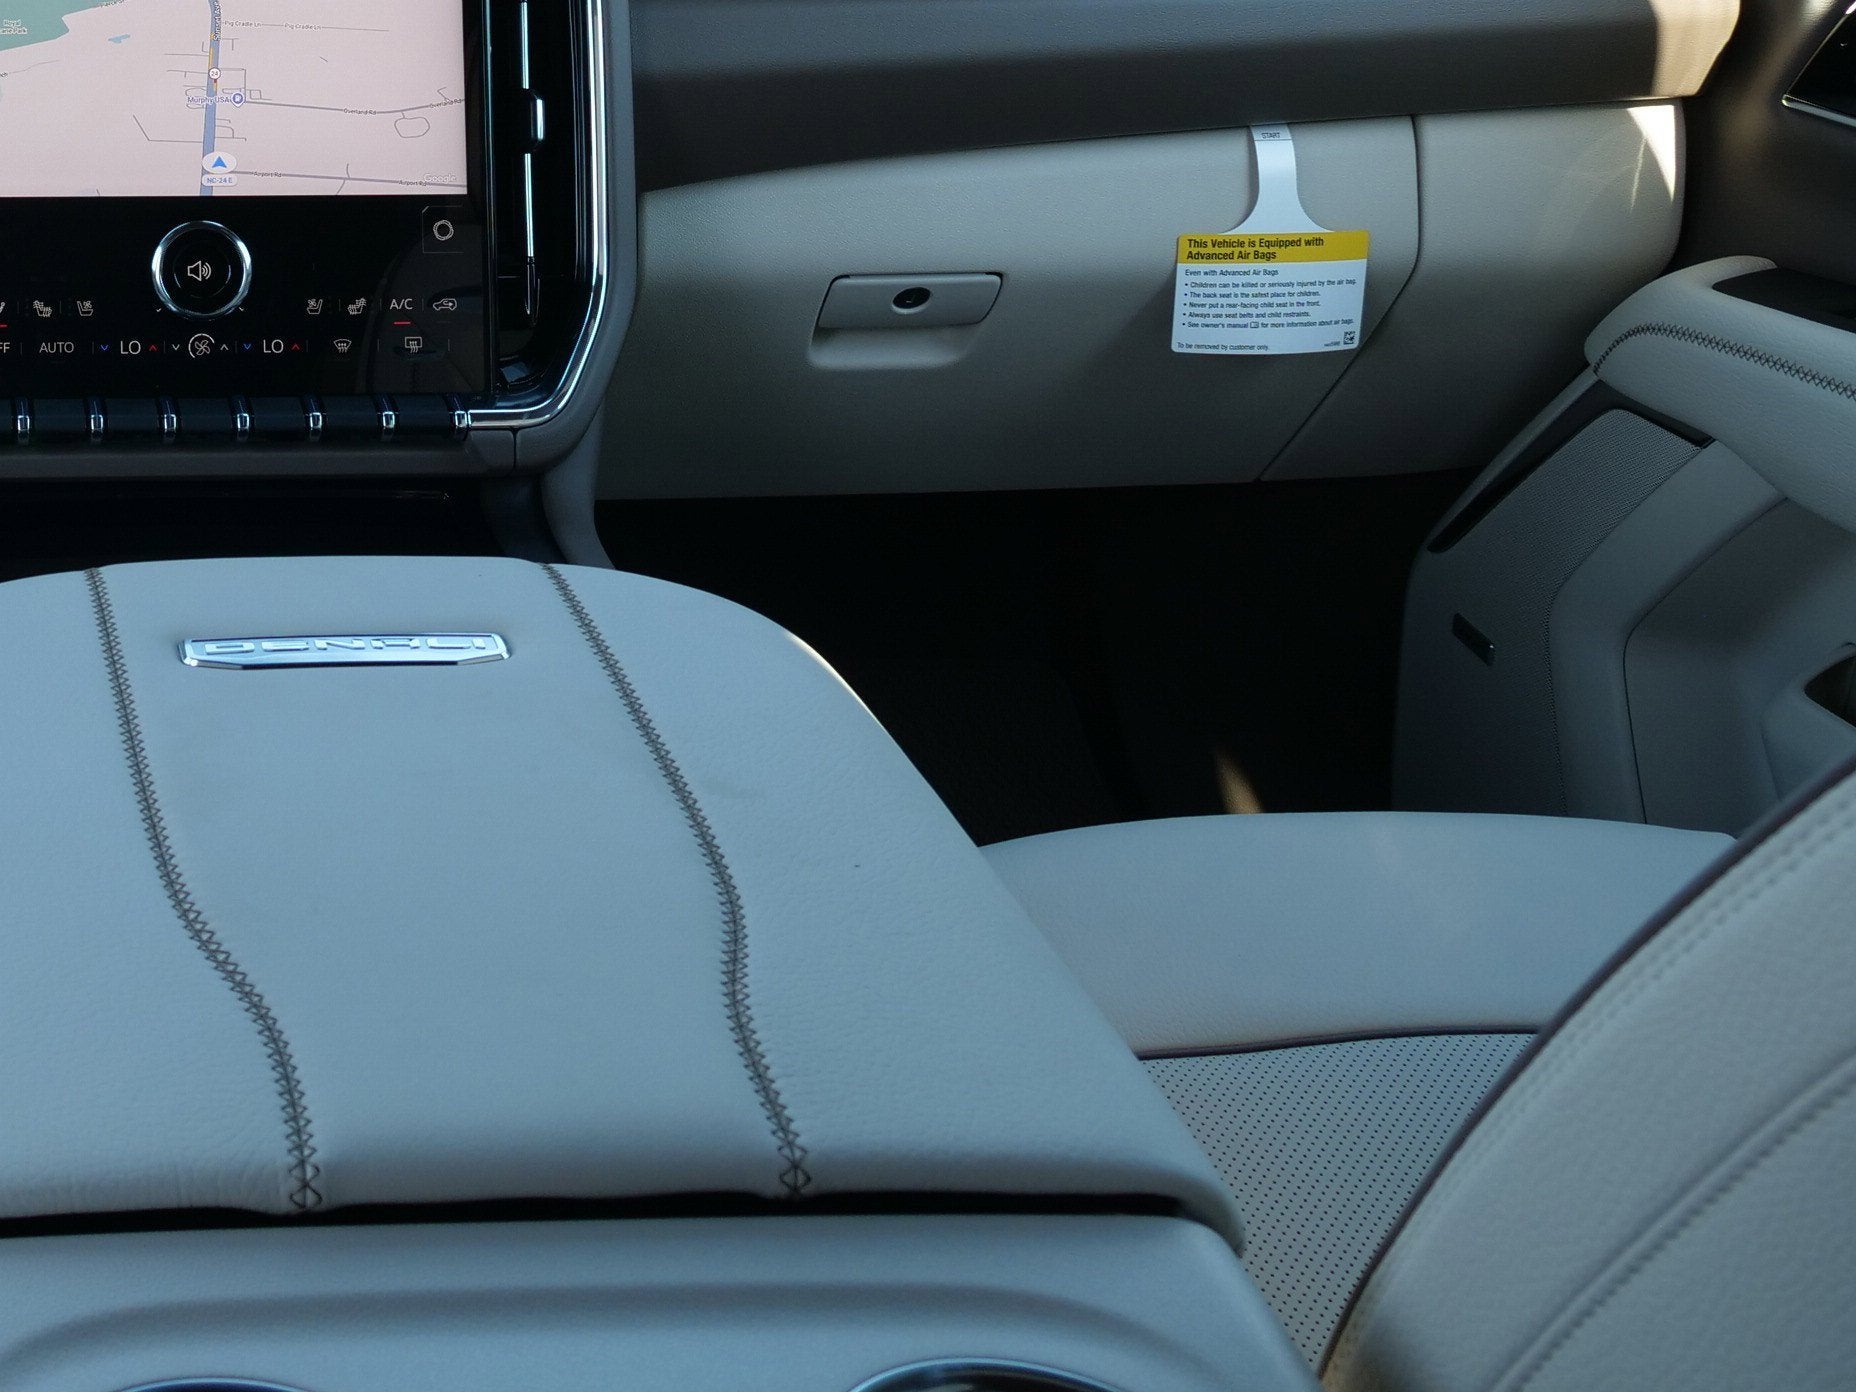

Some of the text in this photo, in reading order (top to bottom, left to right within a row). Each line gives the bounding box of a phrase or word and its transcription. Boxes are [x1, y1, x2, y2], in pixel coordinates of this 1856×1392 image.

[187, 96, 231, 105] Murphy USA
[343, 108, 368, 116] Overland
[253, 171, 274, 179] Airport
[423, 172, 457, 184] Google
[1187, 236, 1324, 249] This Vehicle is Equipped with
[1186, 250, 1277, 261] Advanced Air Bags
[1262, 269, 1279, 277] Bags
[1189, 281, 1218, 289] Children
[390, 297, 413, 312] A/C
[1188, 311, 1211, 319] Always
[39, 341, 75, 355] AUTO
[120, 340, 141, 355] LO
[262, 339, 284, 354] LO
[1177, 341, 1185, 349] To
[205, 637, 487, 655] DENALI
